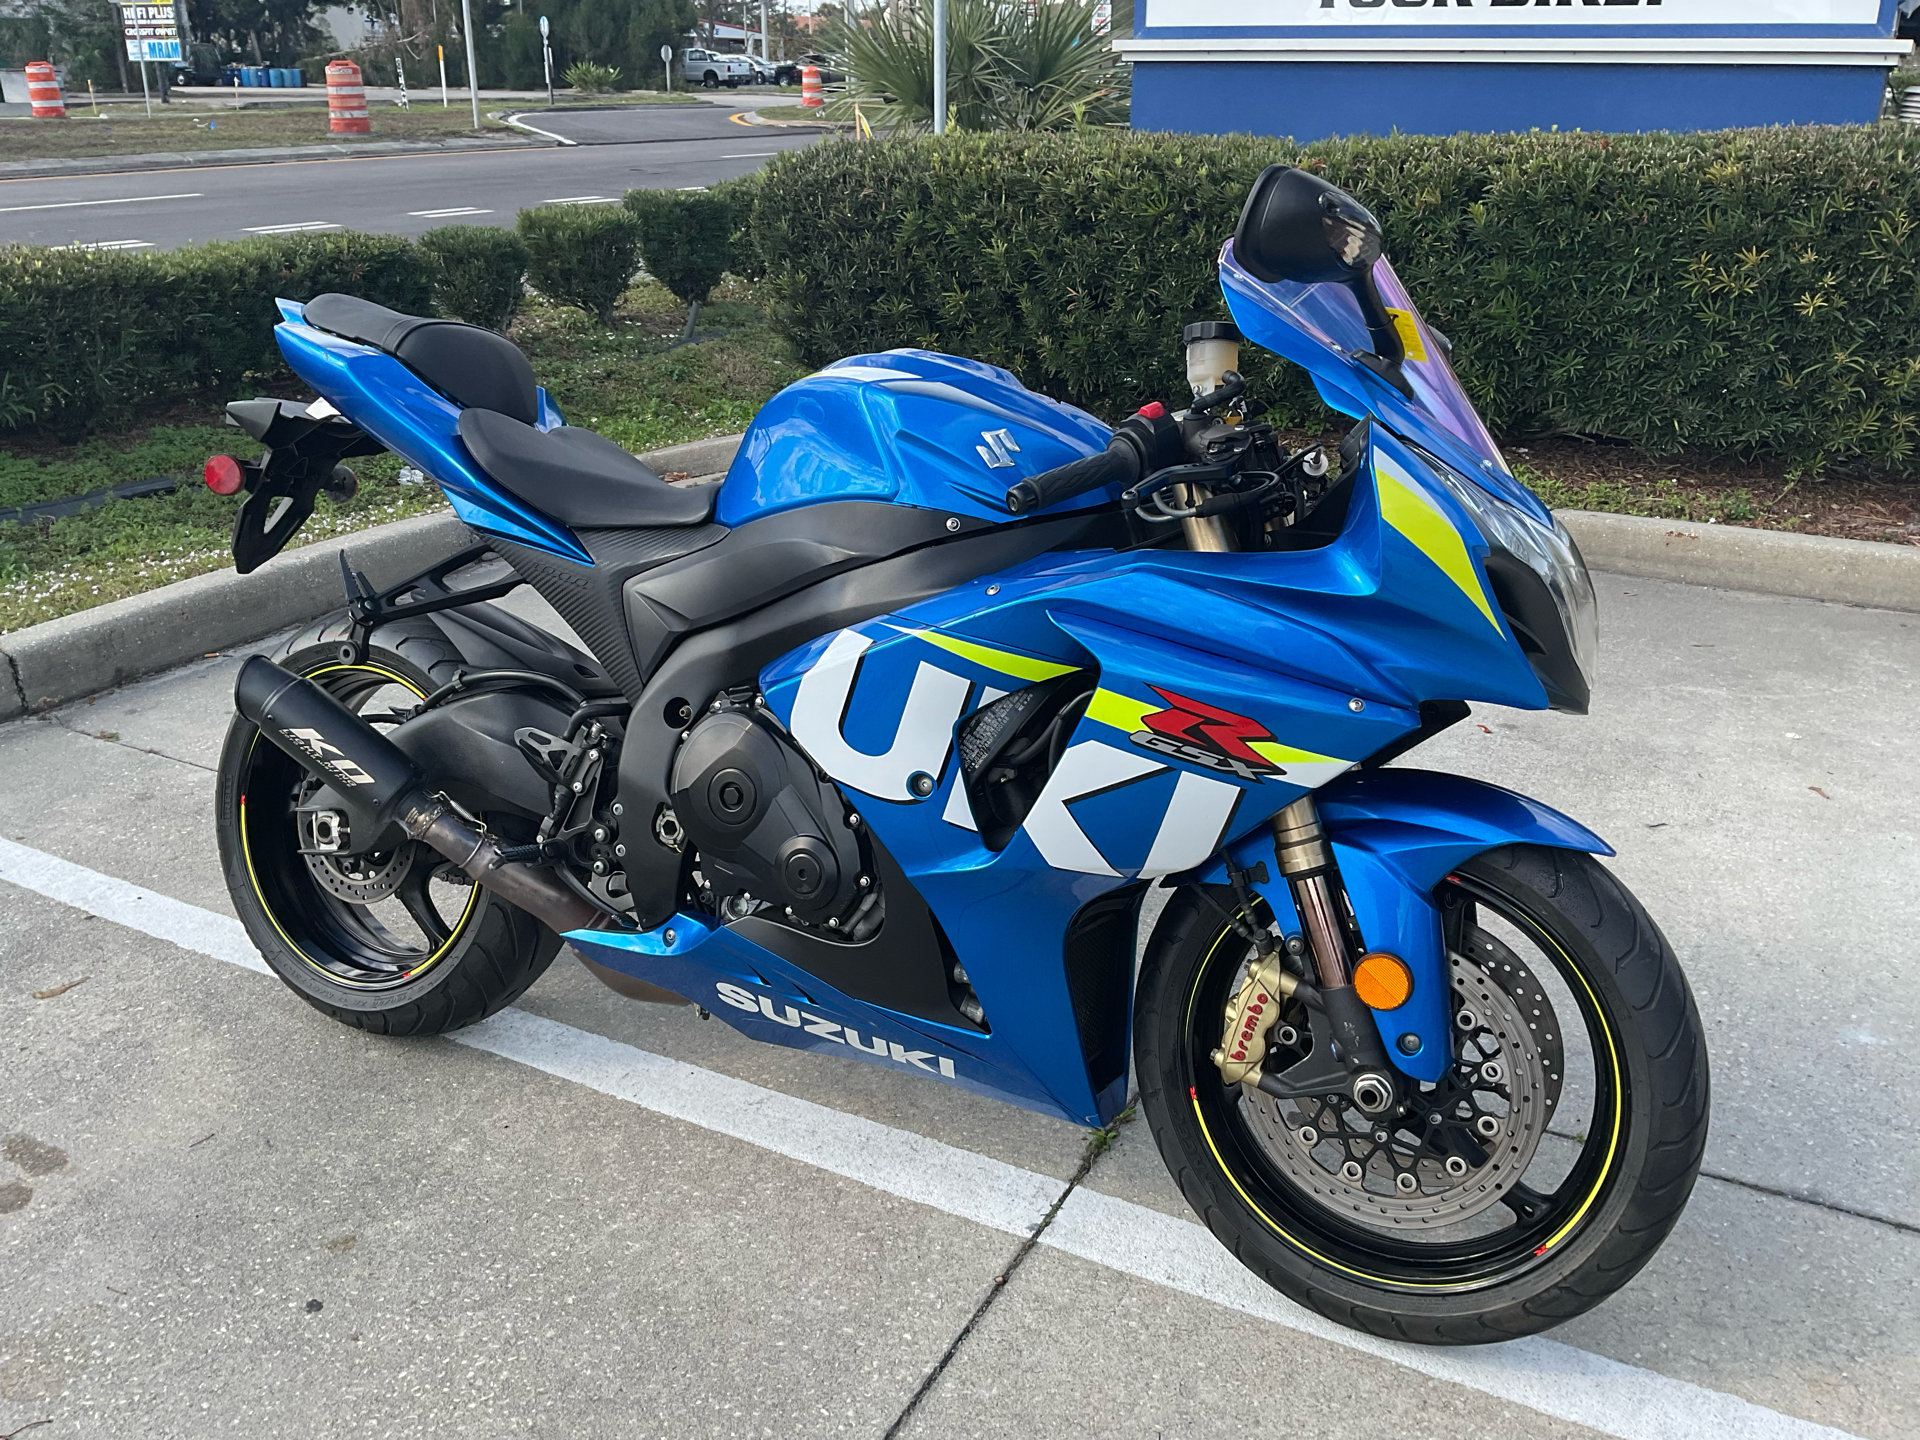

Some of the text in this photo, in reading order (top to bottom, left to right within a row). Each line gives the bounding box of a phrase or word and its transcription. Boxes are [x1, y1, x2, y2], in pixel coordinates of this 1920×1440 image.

[147, 7, 174, 19] PLUS
[1129, 730, 1272, 784] GSX
[716, 982, 955, 1079] SUZUKI
[1229, 992, 1269, 1062] brembo
